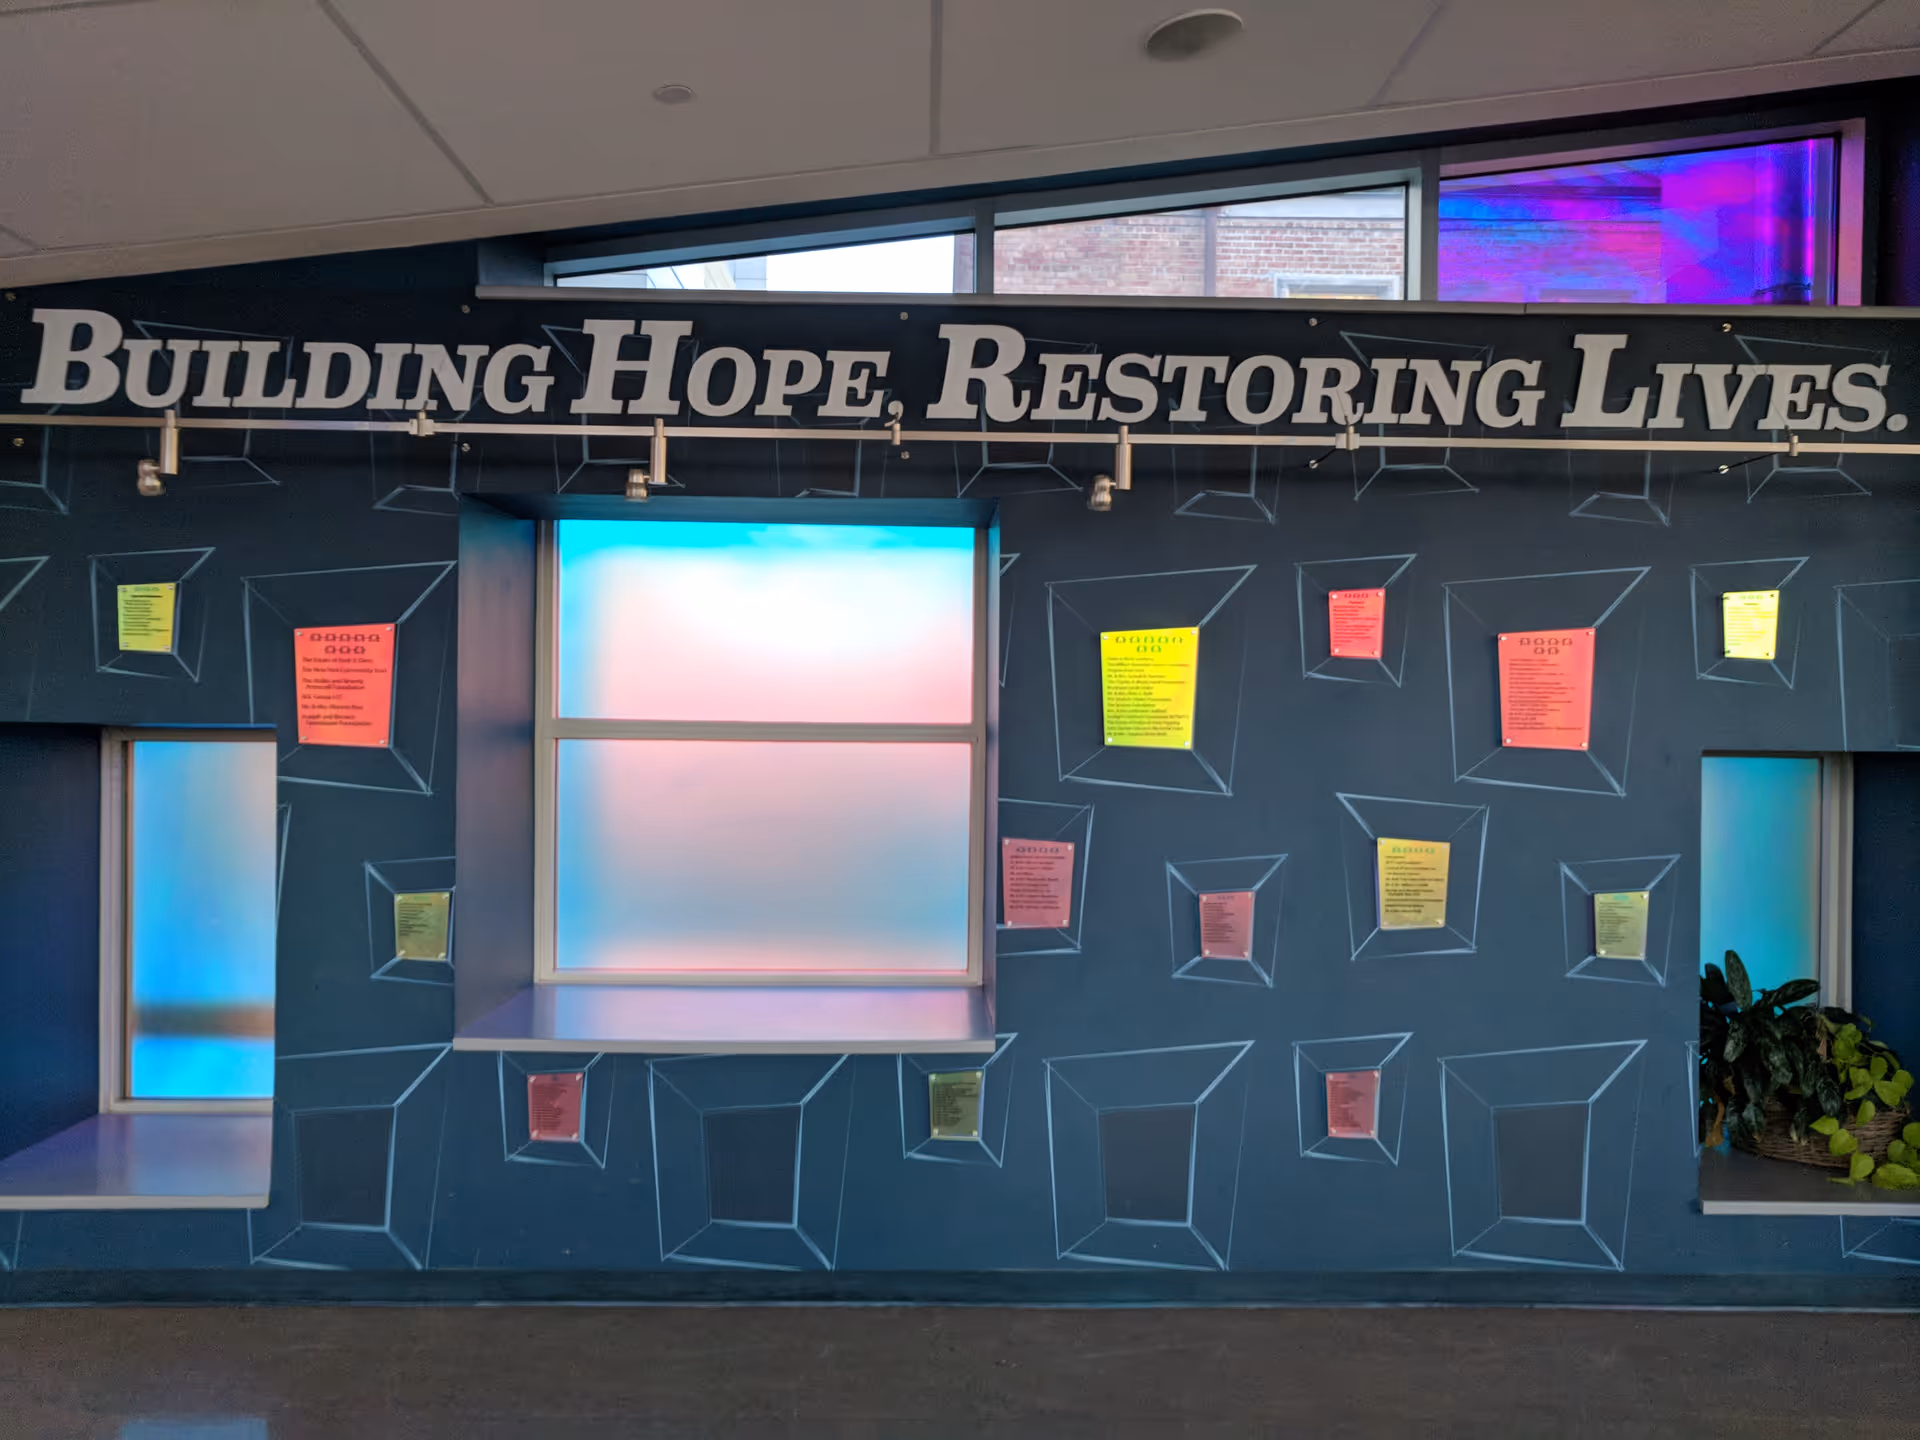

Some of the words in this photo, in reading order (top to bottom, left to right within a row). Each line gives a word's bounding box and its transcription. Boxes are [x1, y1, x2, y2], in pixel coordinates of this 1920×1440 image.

[21, 308, 555, 413] BUILDING
[927, 323, 1545, 428] RESTORING
[1561, 333, 1908, 433] LIVES.
